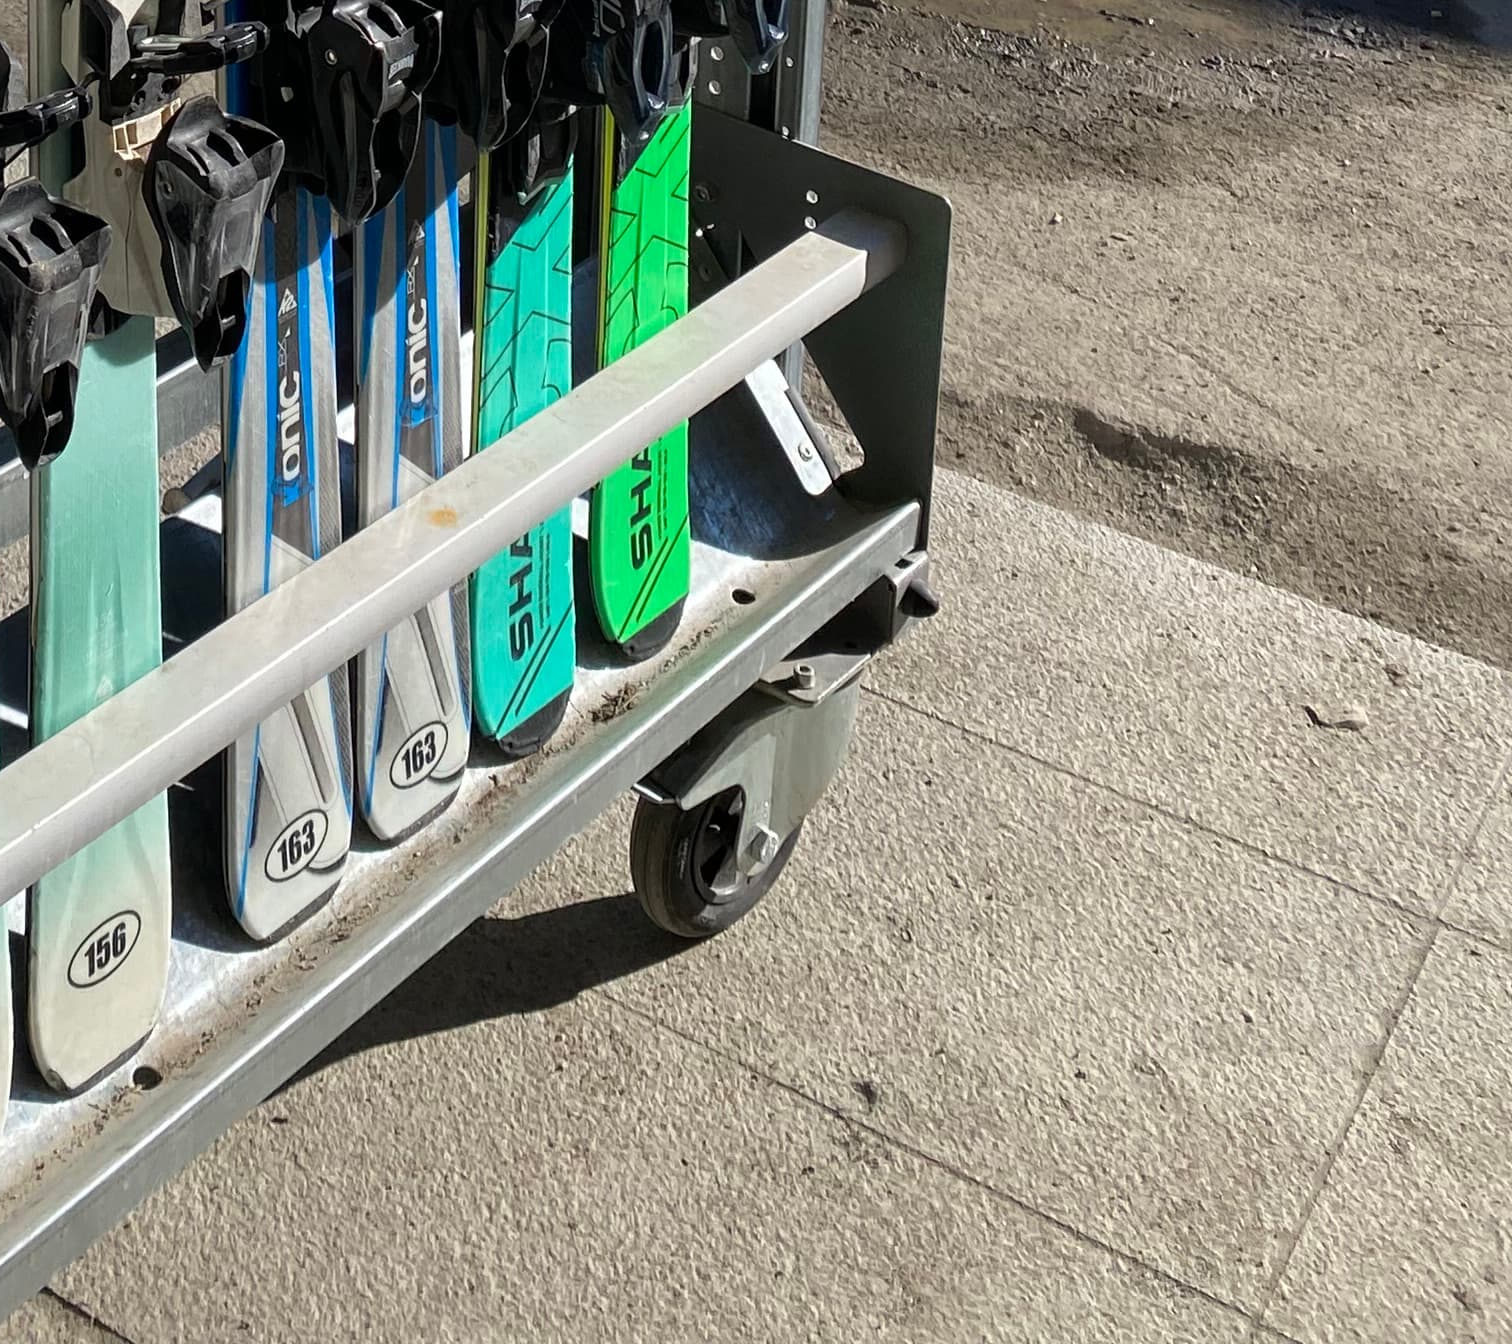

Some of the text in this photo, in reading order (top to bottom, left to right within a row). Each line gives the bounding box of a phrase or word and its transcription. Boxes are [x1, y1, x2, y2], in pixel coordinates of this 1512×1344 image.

[630, 447, 653, 570] SHA
[509, 533, 534, 661] SHA
[401, 731, 436, 779] 163
[277, 820, 315, 872] 163
[85, 921, 127, 978] 156
